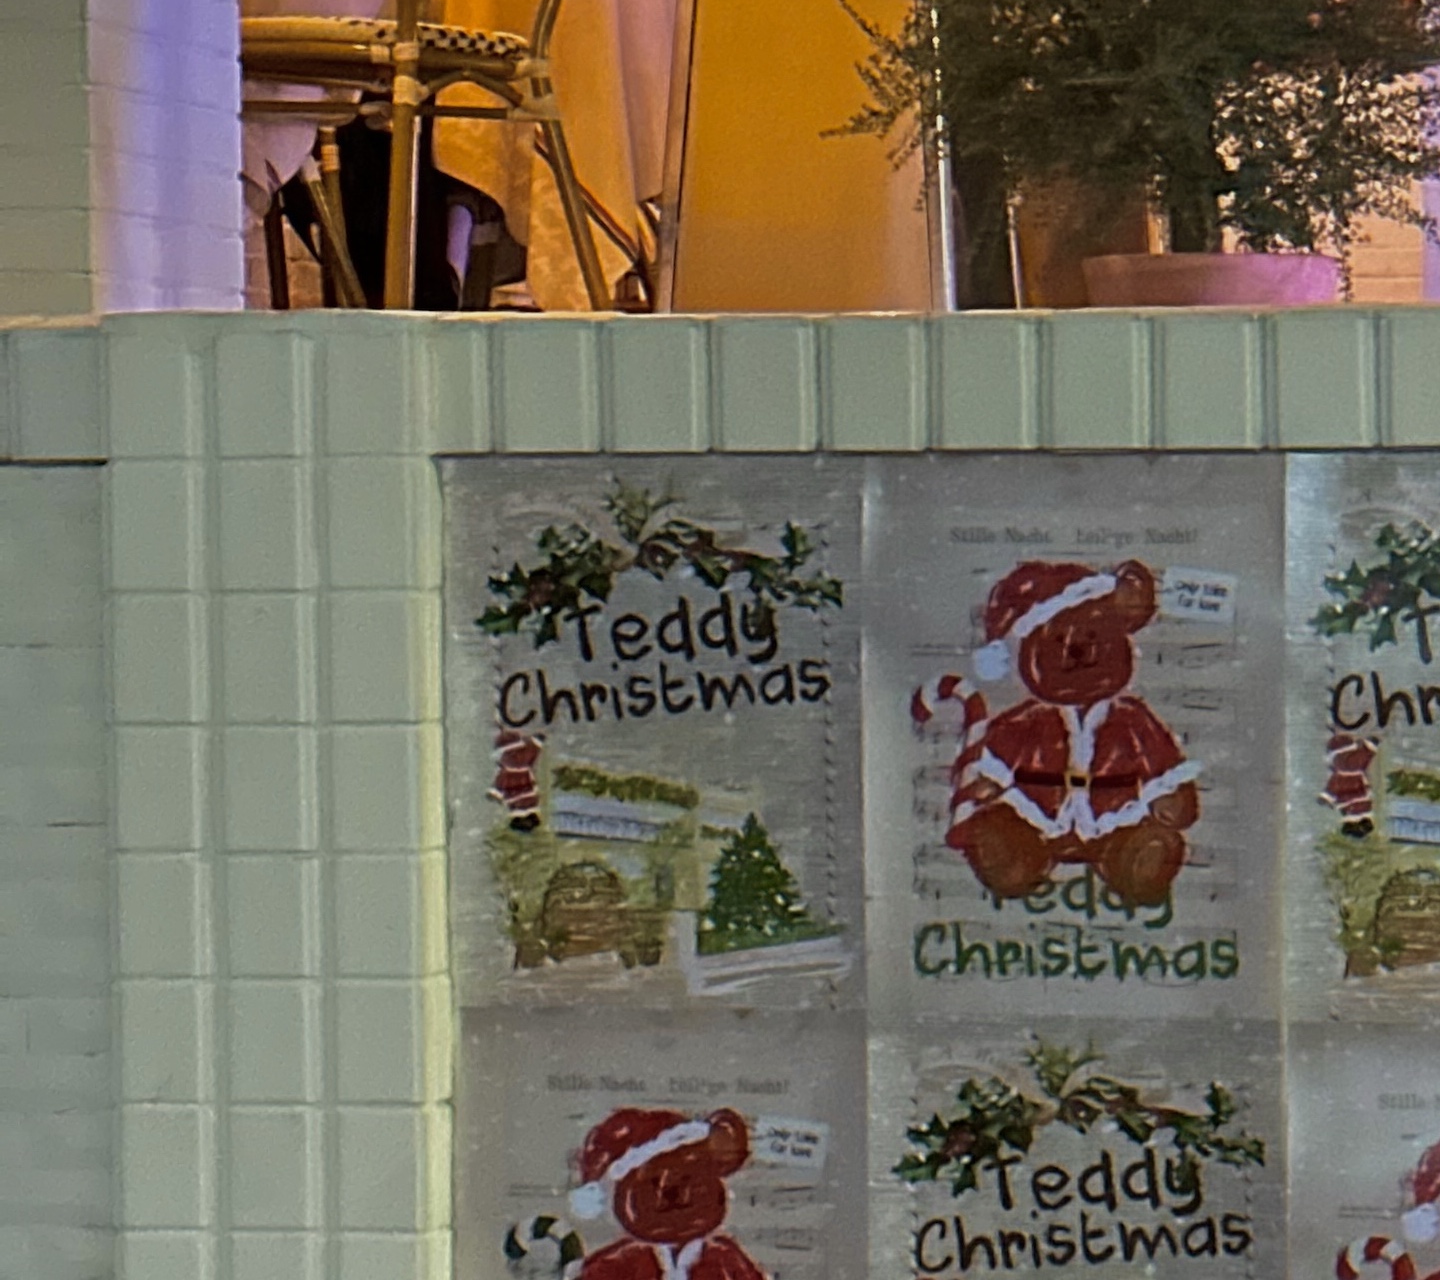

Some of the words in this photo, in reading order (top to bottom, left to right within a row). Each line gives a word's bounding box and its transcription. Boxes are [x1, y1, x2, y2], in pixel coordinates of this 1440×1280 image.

[564, 592, 779, 665] Teddy
[500, 658, 832, 727] Christmas
[914, 923, 1239, 980] Christmas
[983, 1148, 1203, 1216] Teddy
[914, 1210, 1252, 1273] Christmas
